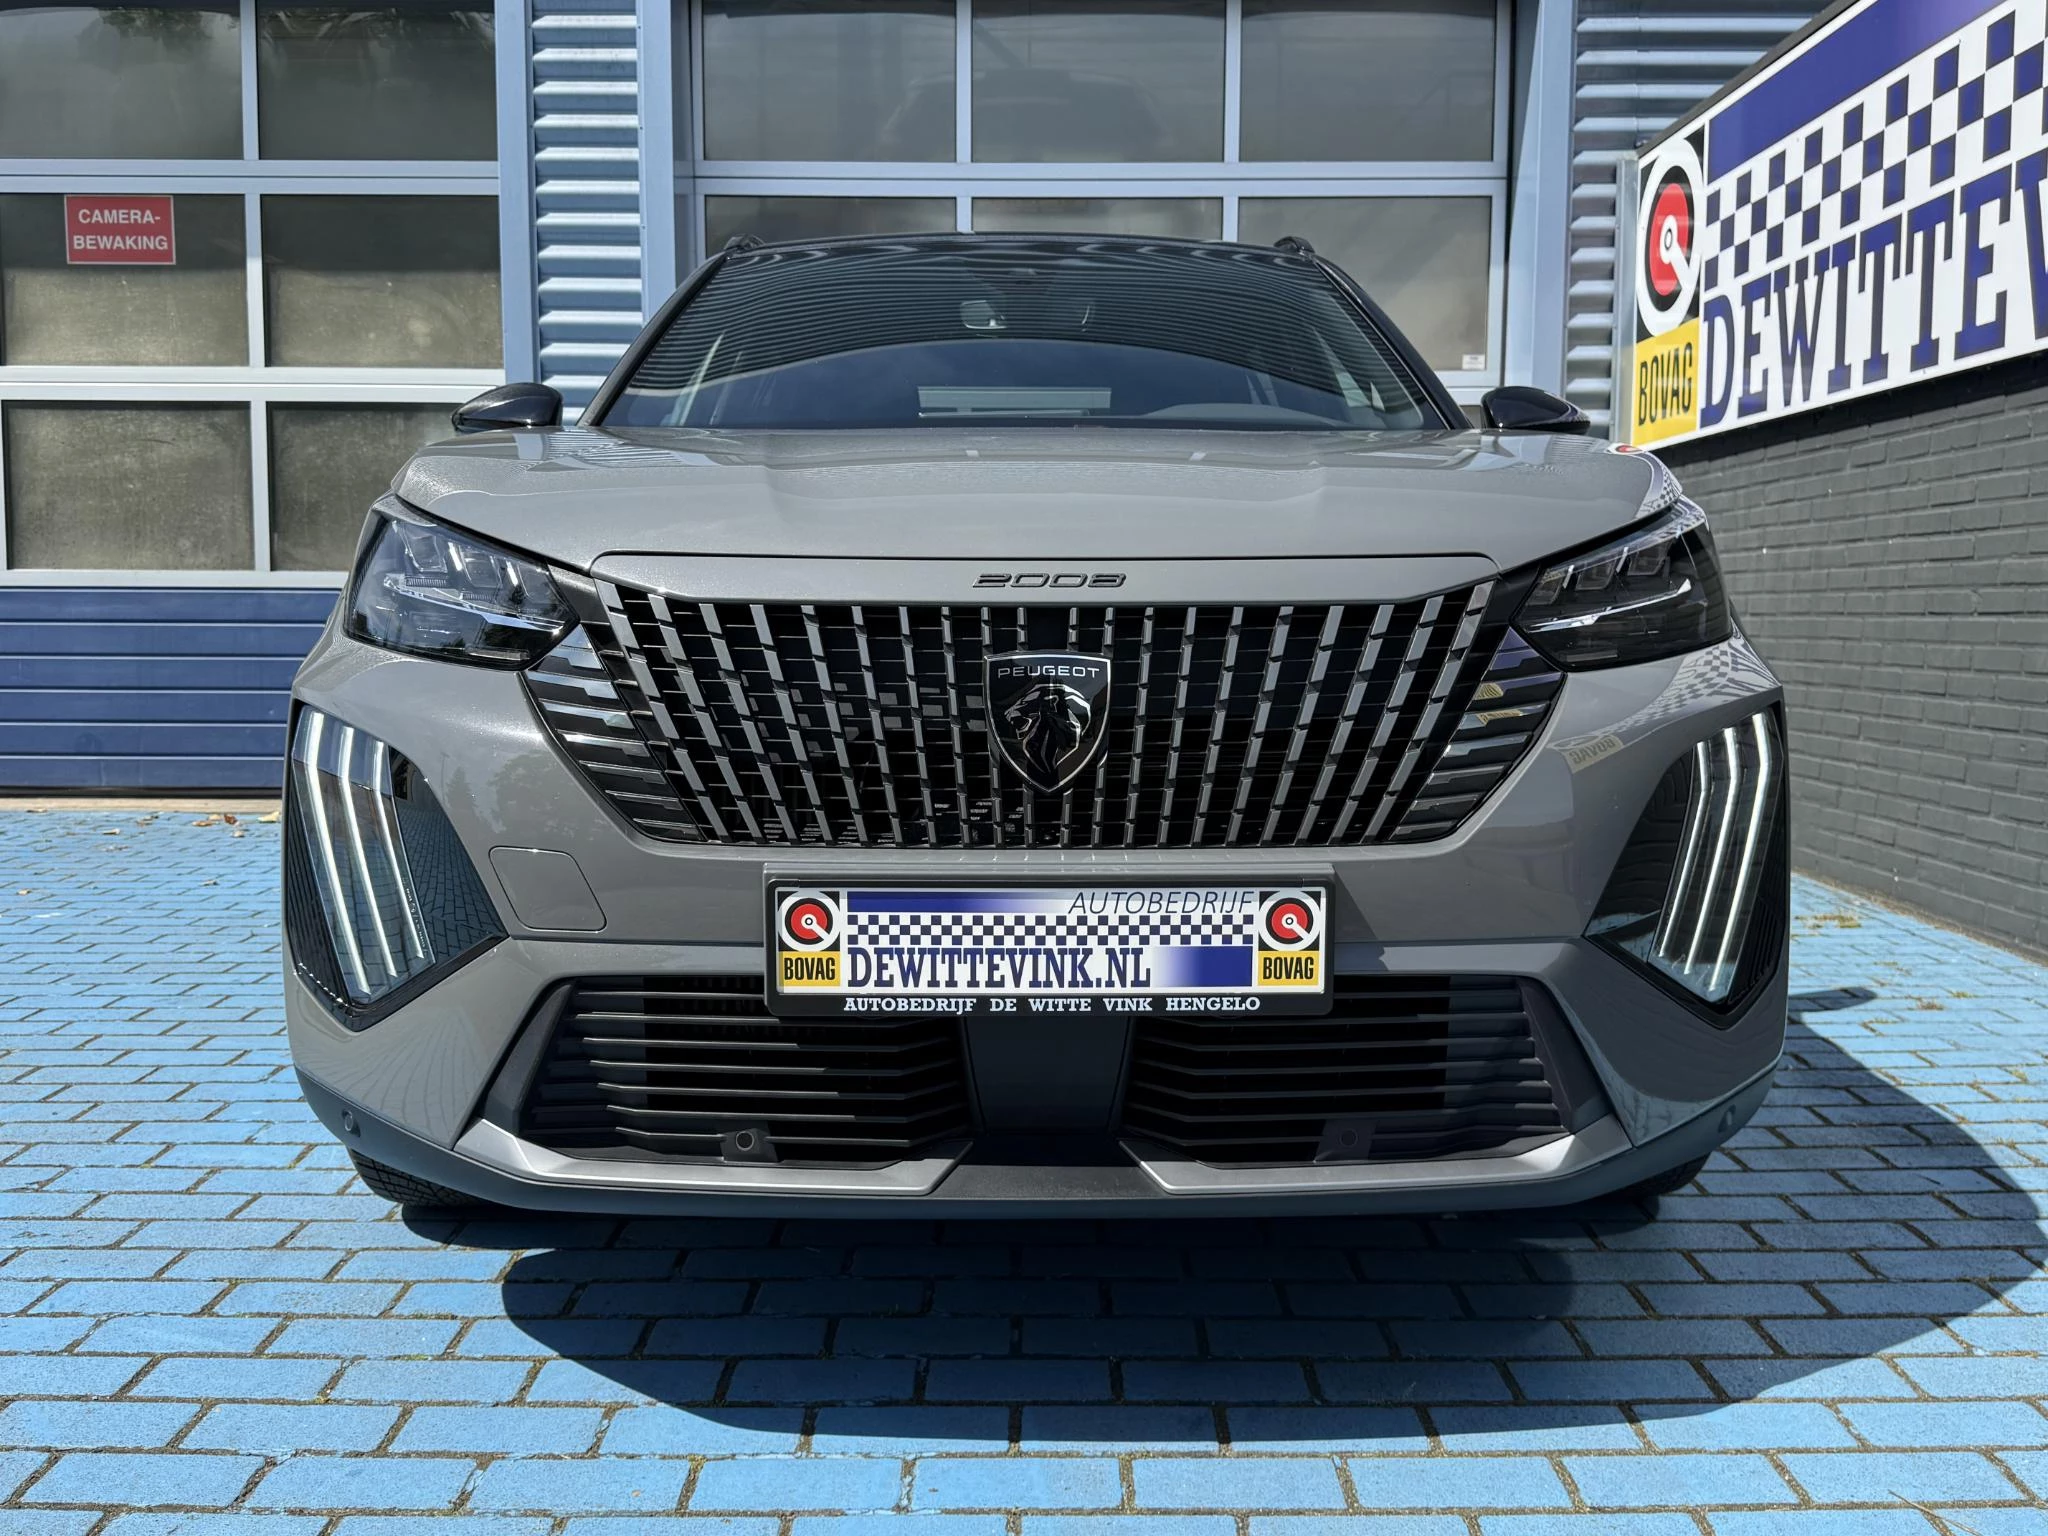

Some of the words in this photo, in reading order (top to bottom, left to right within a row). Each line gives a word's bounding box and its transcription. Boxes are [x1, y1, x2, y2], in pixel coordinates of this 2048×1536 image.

[78, 208, 161, 224] CAMERA-
[73, 235, 169, 250] BEWAKING
[1638, 341, 1693, 426] BOVAG
[972, 572, 1127, 588] 2008
[997, 664, 1100, 679] PEUGEOT
[1068, 891, 1254, 914] AUTOBEDRIJF
[784, 957, 836, 981] BOVAG
[847, 946, 1151, 988] DEWITTEVINK.NL
[1262, 956, 1315, 980] BOVAG
[843, 997, 976, 1015] AUTOBEDRIJF
[989, 998, 1017, 1012] DE
[1028, 998, 1092, 1012] WITTE
[1103, 997, 1153, 1012] VINK
[1165, 996, 1261, 1012] HENGELO
